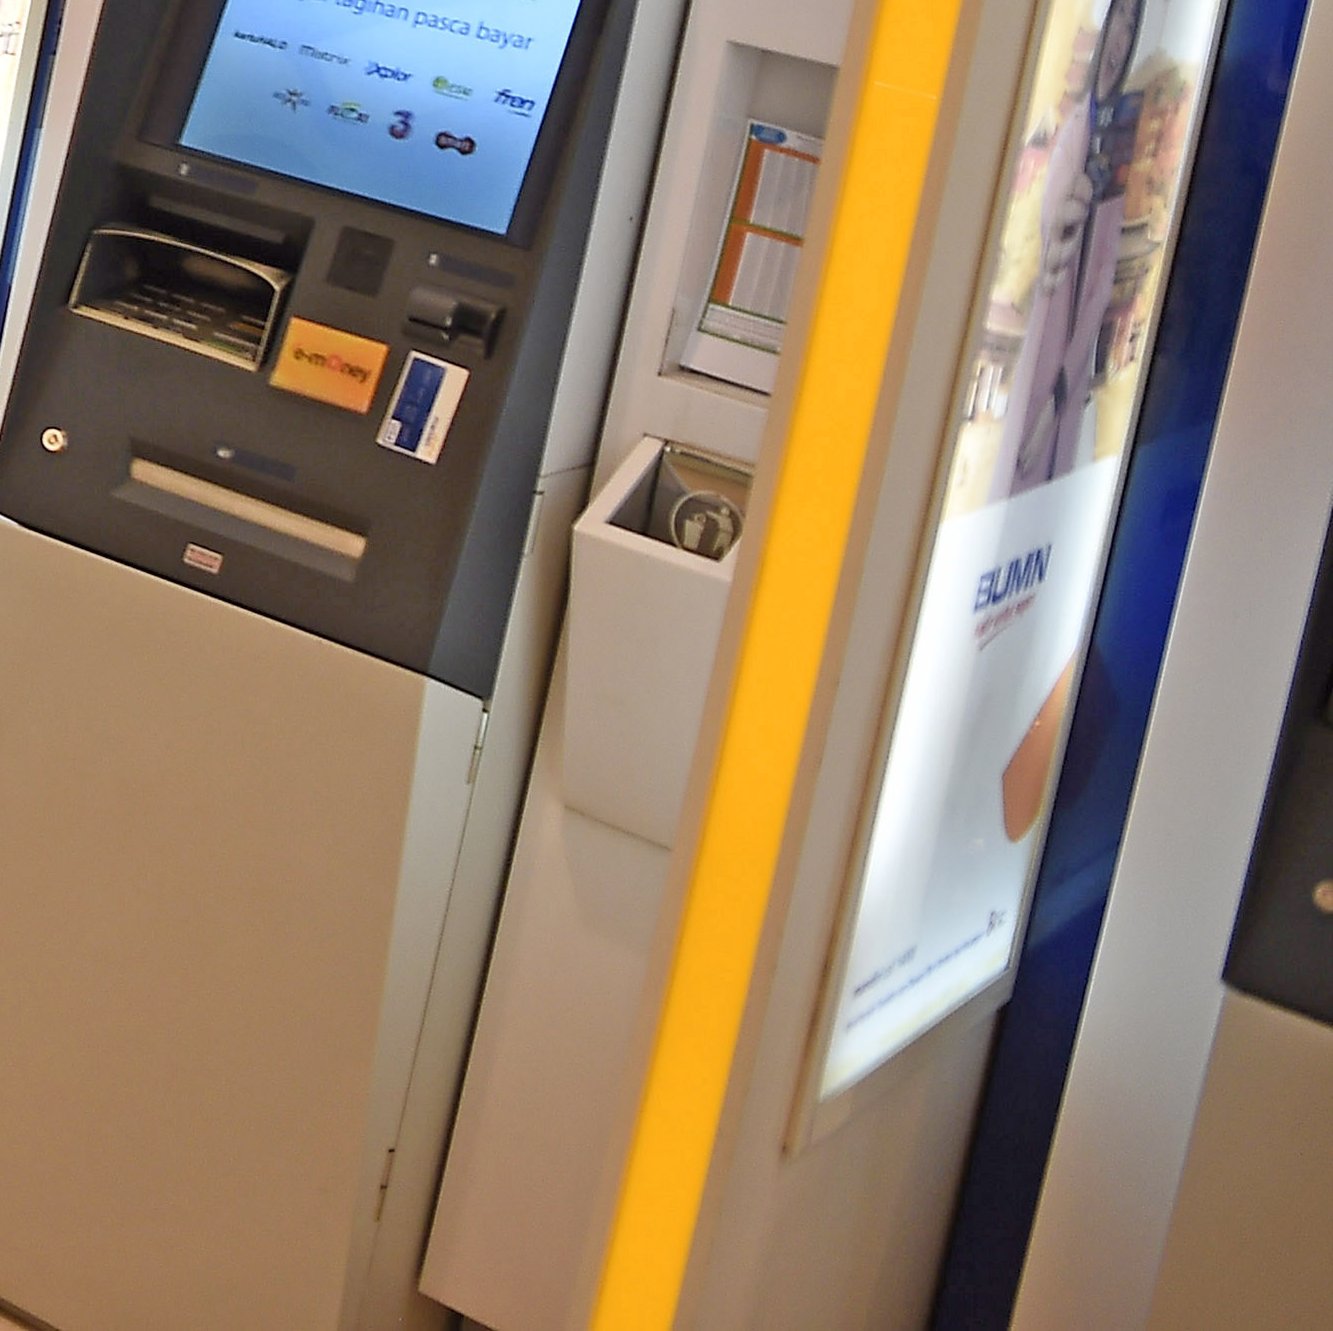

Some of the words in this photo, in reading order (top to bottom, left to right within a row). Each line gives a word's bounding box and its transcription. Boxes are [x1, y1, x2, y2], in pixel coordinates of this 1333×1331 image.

[413, 10, 471, 35] pasca
[476, 20, 535, 50] bayar
[293, 344, 370, 385] e-money
[974, 544, 1052, 614] BUMN
